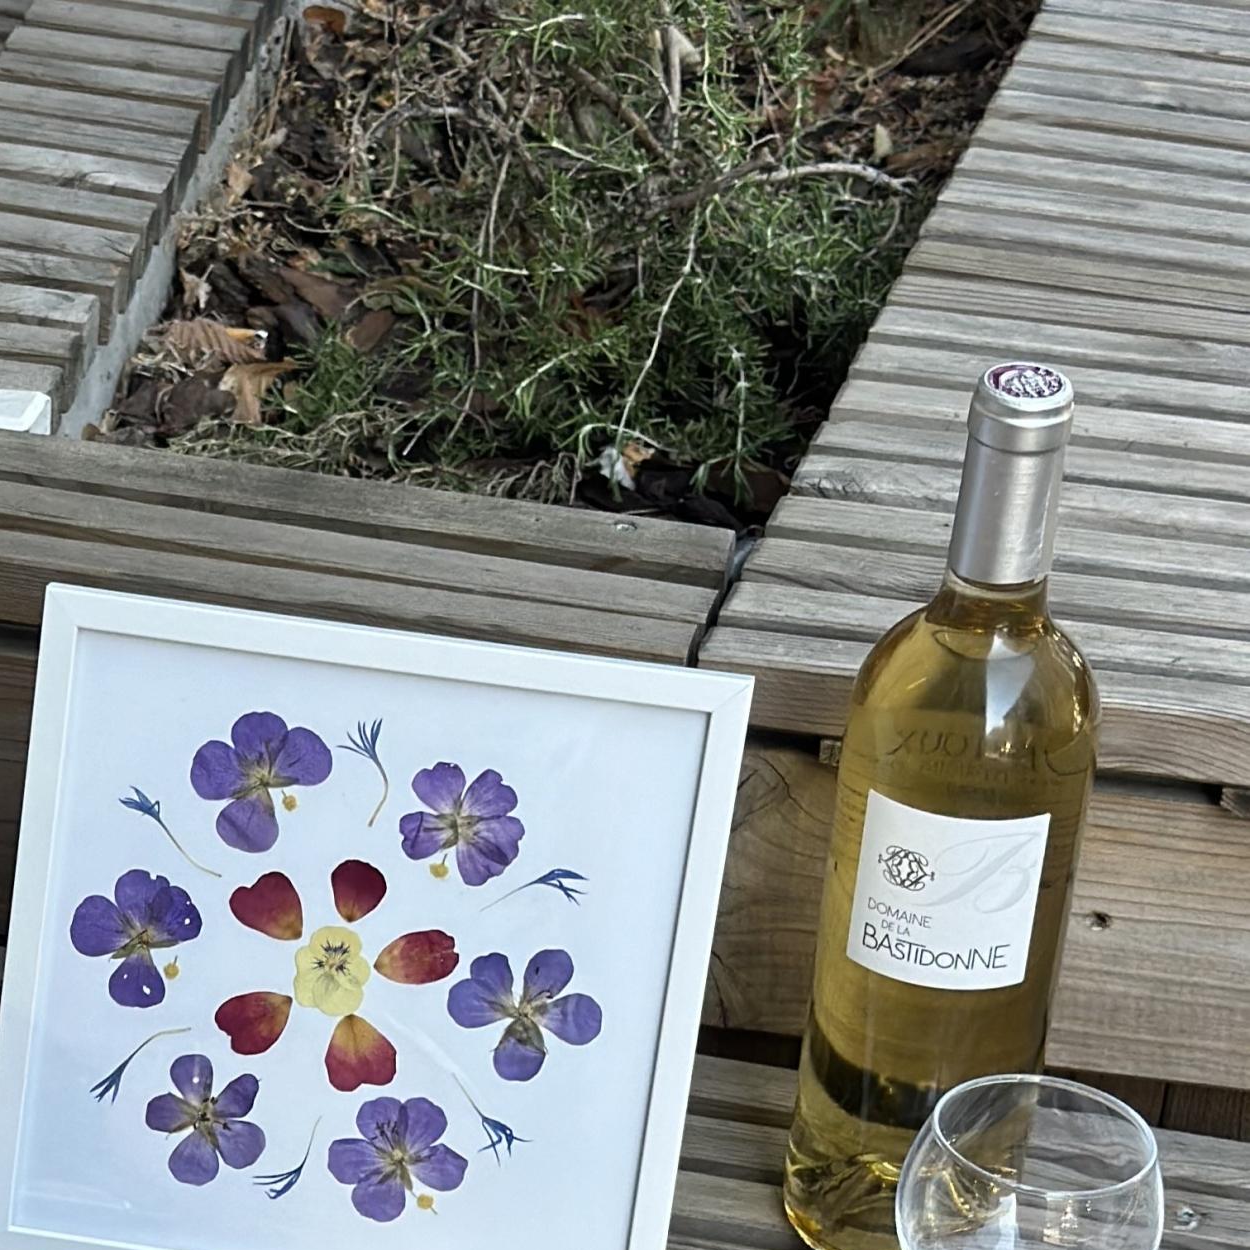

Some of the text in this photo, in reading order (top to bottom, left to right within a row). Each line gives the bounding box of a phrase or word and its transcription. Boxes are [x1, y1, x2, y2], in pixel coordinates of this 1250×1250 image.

[867, 897, 933, 929] DOMAINE
[881, 919, 911, 937] DE LA
[862, 922, 1011, 970] BASTIDONNE
